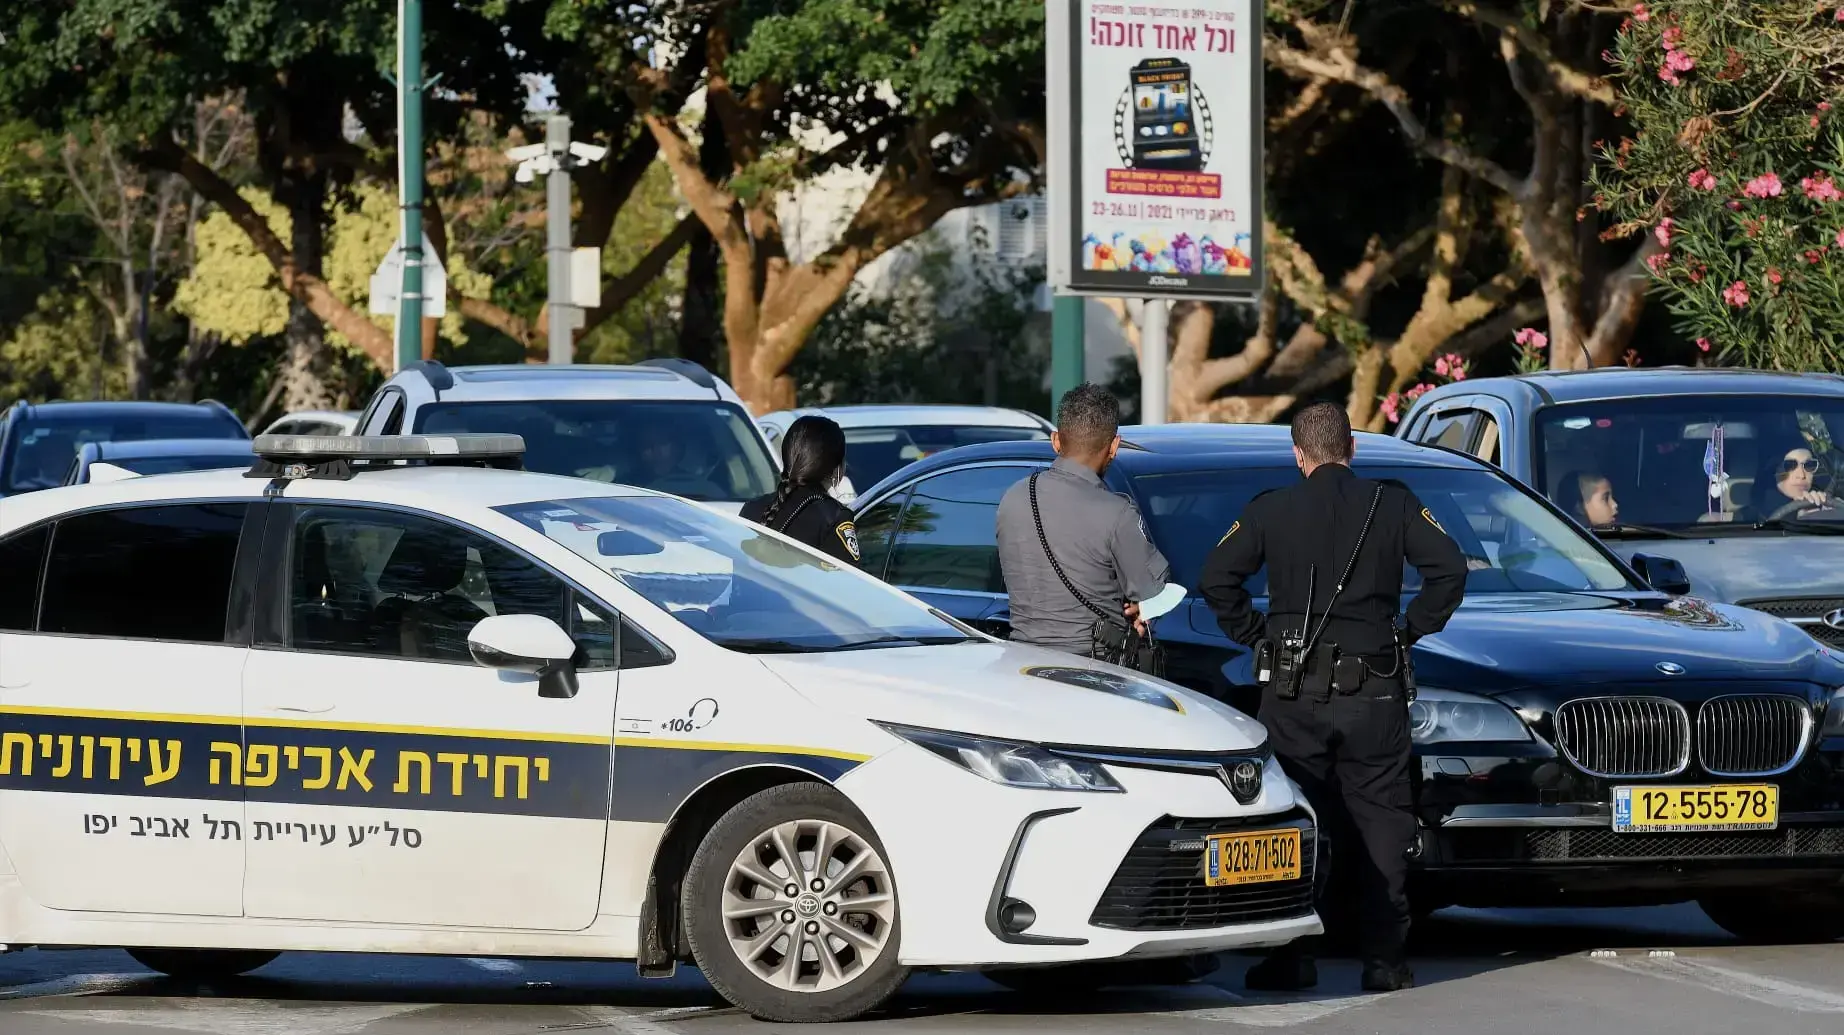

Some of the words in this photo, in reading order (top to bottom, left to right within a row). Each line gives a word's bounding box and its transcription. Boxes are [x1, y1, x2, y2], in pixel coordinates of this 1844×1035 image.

[1090, 16, 1146, 47] זוכה!
[1152, 24, 1197, 51] אחד
[1204, 23, 1236, 53] וכל
[1138, 74, 1161, 83] BLACK
[1148, 204, 1173, 218] 2021
[1209, 209, 1236, 222] בלאק
[0, 732, 182, 787] עירונית
[209, 741, 376, 793] אכיפה
[393, 750, 550, 800] יחידת
[1618, 800, 1629, 814] IL
[83, 813, 118, 835] יפו
[129, 816, 191, 840] אביב
[202, 813, 242, 841] תל
[253, 820, 336, 846] עיריית
[1211, 850, 1218, 867] IL
